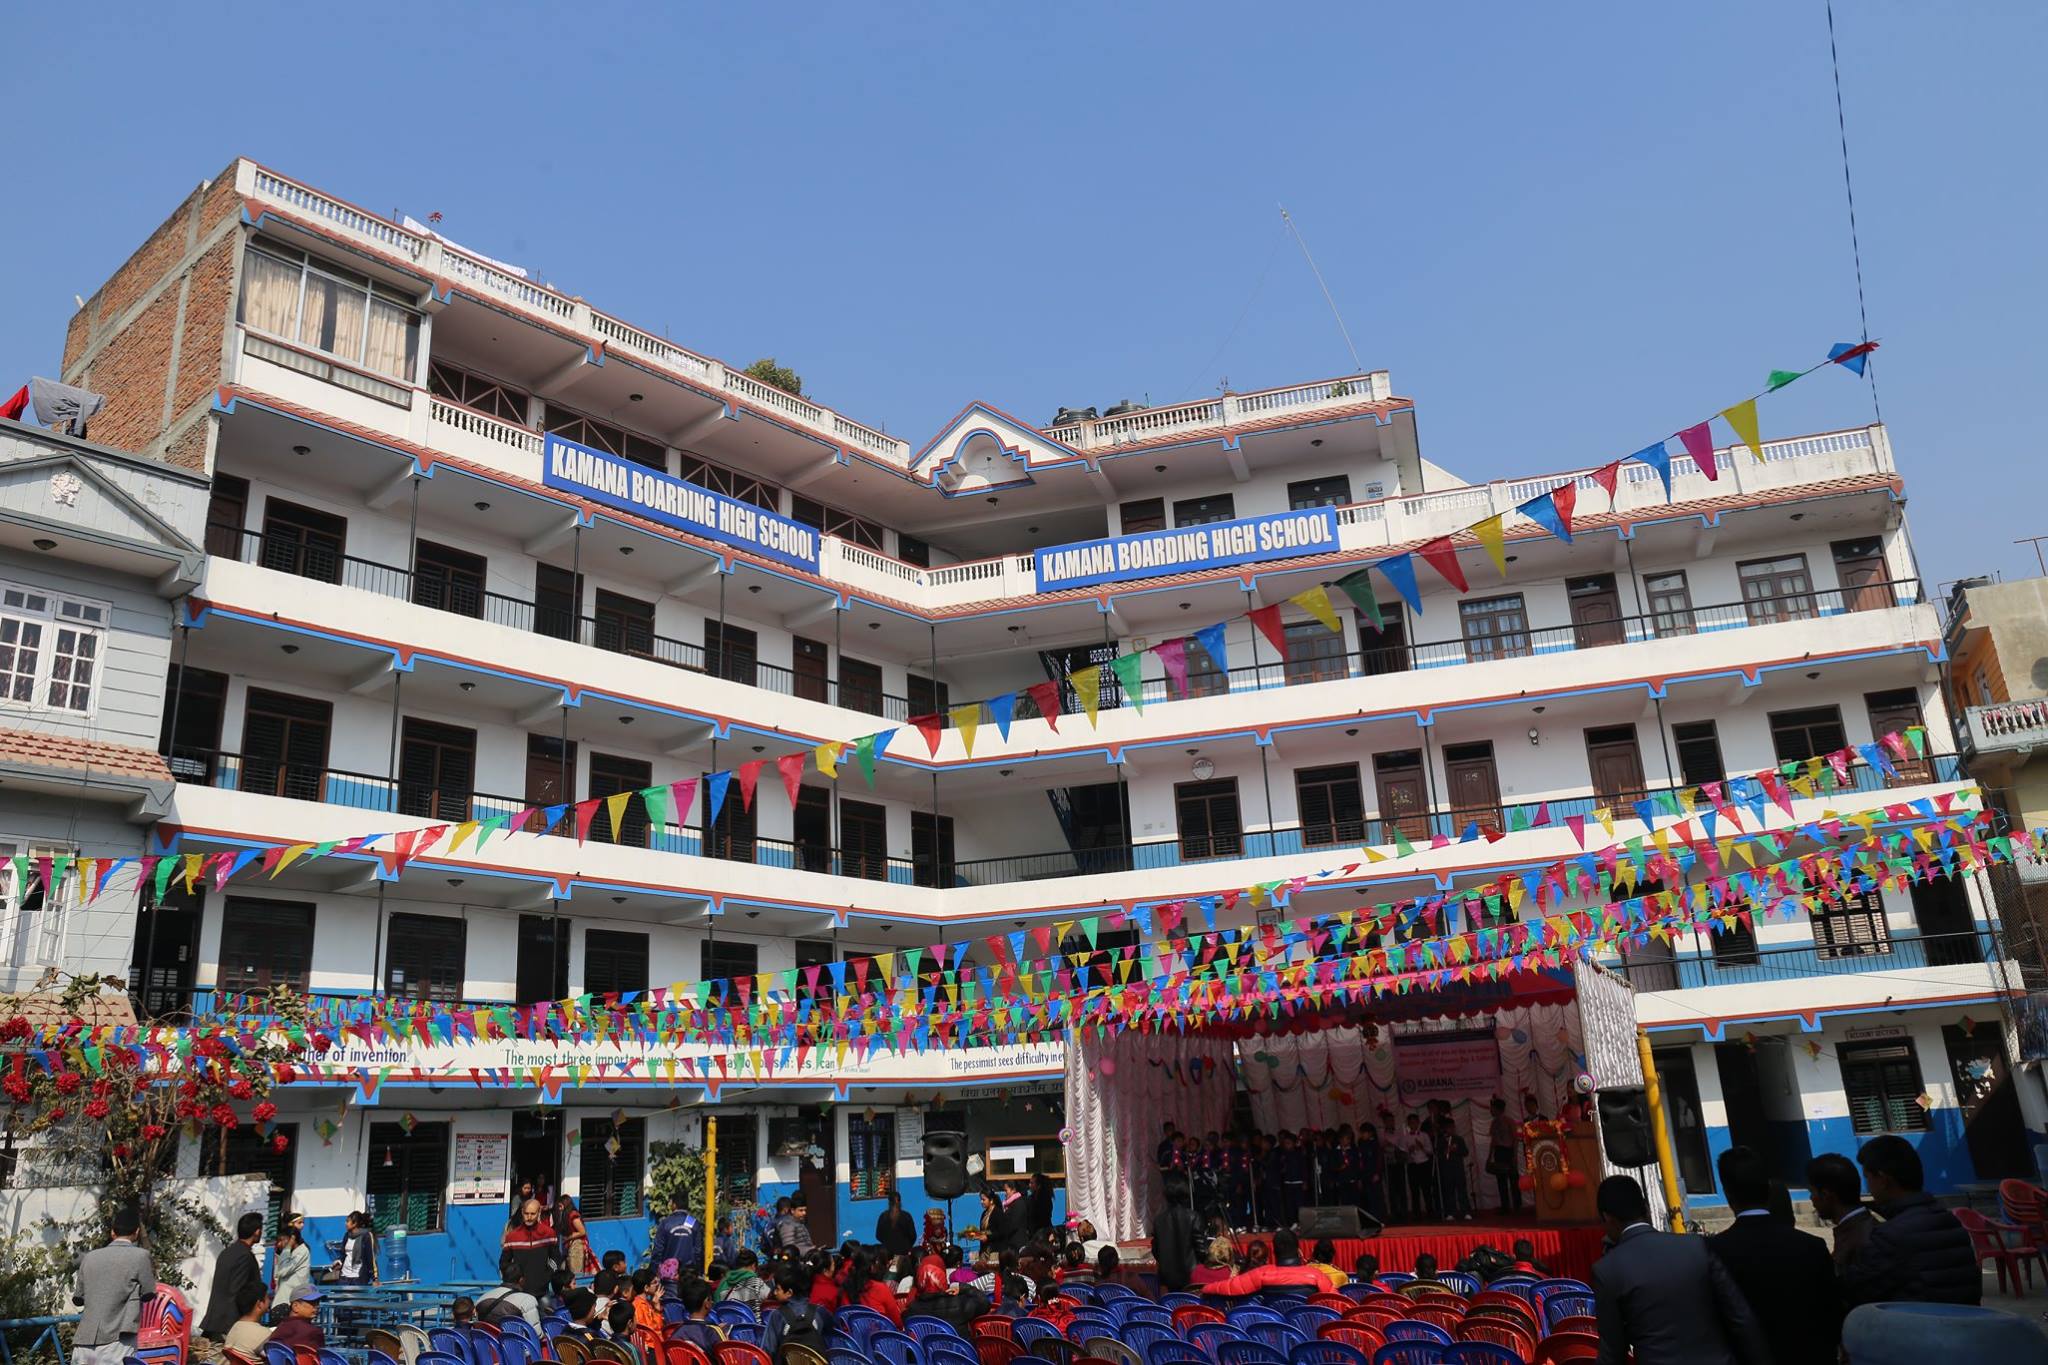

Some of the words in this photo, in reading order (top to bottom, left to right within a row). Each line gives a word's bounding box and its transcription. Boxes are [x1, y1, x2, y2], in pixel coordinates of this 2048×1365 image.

[551, 442, 629, 500] KAMANA
[632, 471, 716, 529] BOARDING
[719, 500, 756, 542] HIGH
[759, 512, 815, 563] SCHOOL
[1042, 543, 1116, 583] KAMANA
[1117, 532, 1209, 571] BOARDING
[1211, 524, 1256, 557] HIGH
[1258, 513, 1333, 552] SCHOOL
[1850, 1030, 1873, 1039] ACCOUNT
[300, 1046, 328, 1062] ther
[332, 1046, 346, 1062] of
[505, 1049, 524, 1066] The
[527, 1053, 557, 1065] most
[562, 1051, 592, 1066] three
[950, 1057, 962, 1071] The
[963, 1057, 997, 1073] pessimist
[998, 1056, 1014, 1069] sees
[1015, 1050, 1049, 1066] difficulty
[1050, 1053, 1057, 1062] in
[1417, 1077, 1454, 1087] KAMANA
